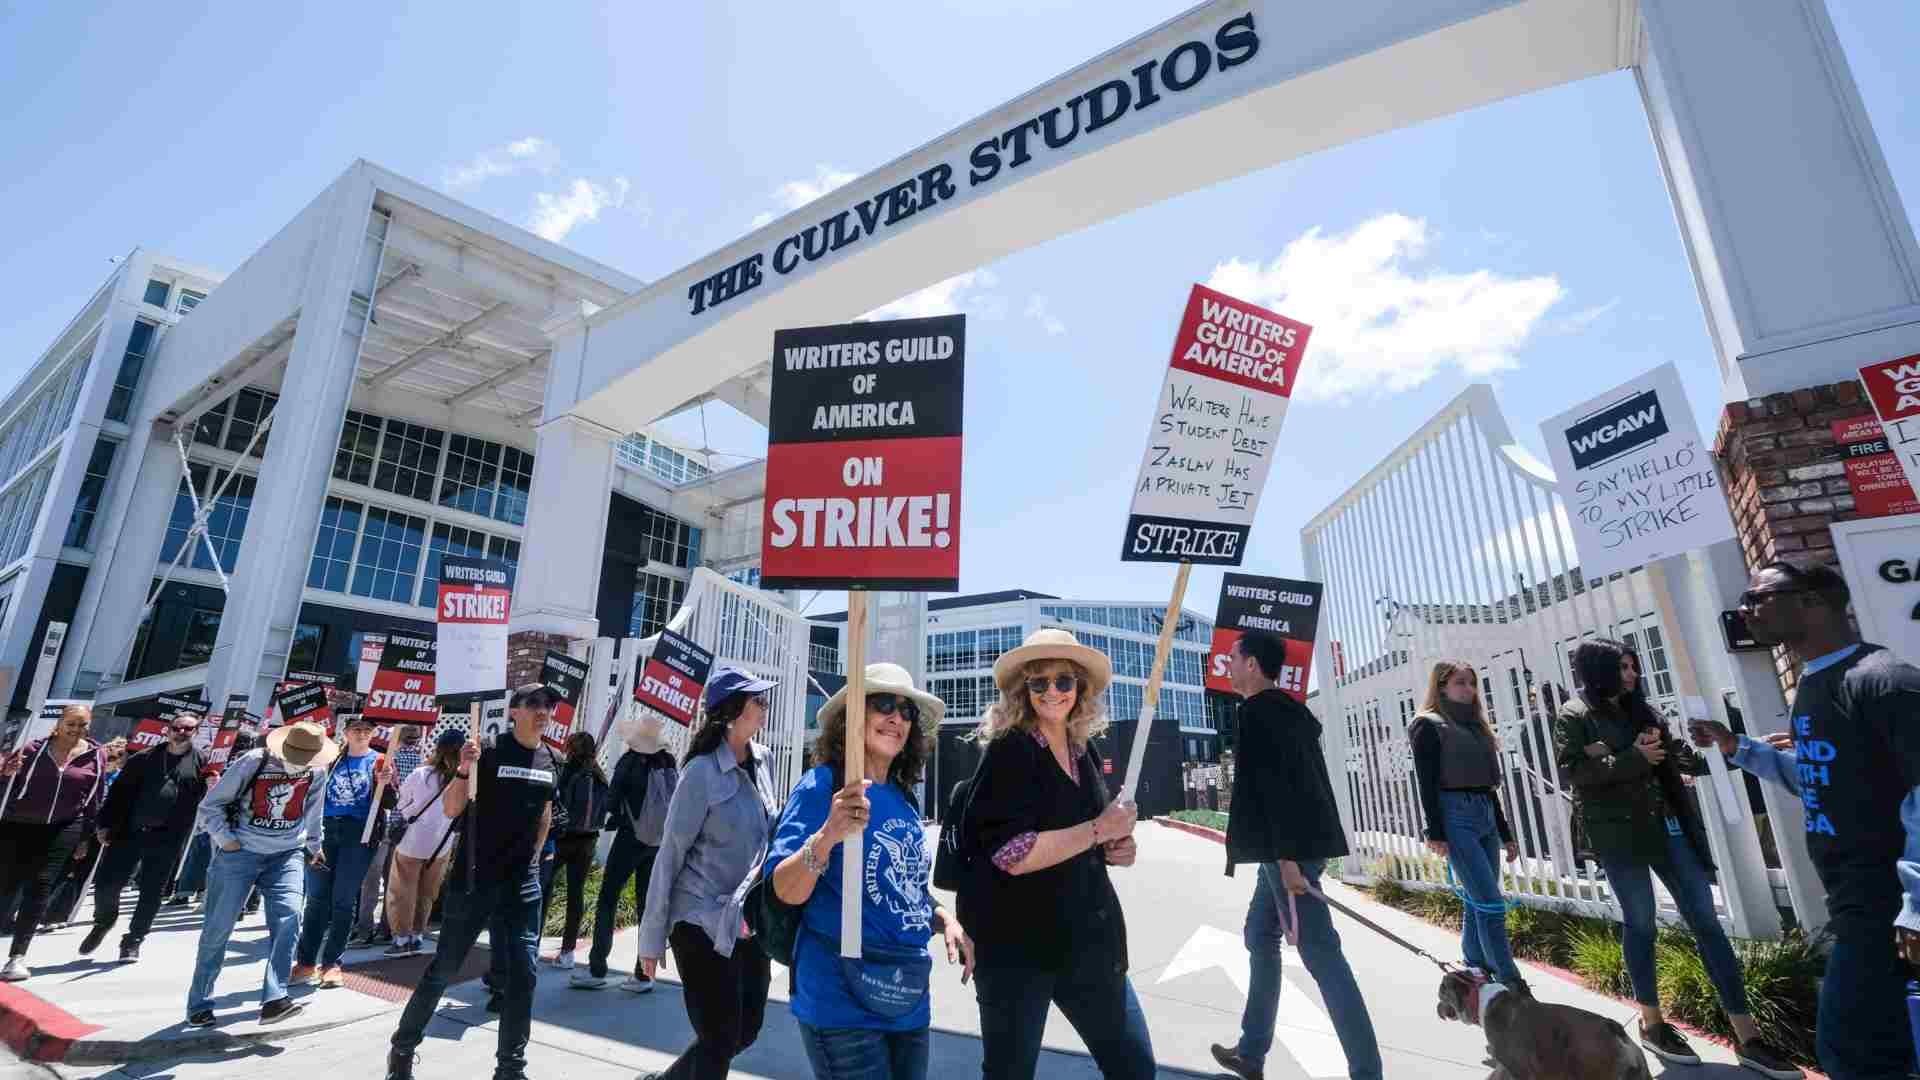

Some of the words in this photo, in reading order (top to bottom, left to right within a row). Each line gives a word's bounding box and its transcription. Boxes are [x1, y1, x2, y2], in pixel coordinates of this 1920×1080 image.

[688, 252, 763, 315] THE
[772, 163, 956, 274] CULVER
[969, 12, 1260, 187] STUDIOS
[1200, 298, 1297, 348] WRITERS
[784, 340, 881, 371] WRITERS
[885, 335, 954, 363] GUILD
[1196, 322, 1266, 360] GUILD
[1265, 347, 1287, 365] OF
[1184, 342, 1285, 387] AMERICA
[852, 374, 877, 394] OF
[812, 401, 915, 430] AMERICA
[1571, 404, 1657, 454] WGAW
[1849, 441, 1885, 456] FIRE
[843, 456, 883, 487] ON
[1140, 477, 1151, 493] A
[1575, 473, 1619, 504] SAY
[1577, 505, 1602, 525] TO
[1616, 483, 1653, 512] MY
[1660, 470, 1716, 502] LITTLE
[770, 493, 951, 549] STRIKE!
[1600, 494, 1700, 548] STRIKE
[1133, 523, 1240, 558] STRIKE
[445, 565, 484, 581] WRITERS
[485, 570, 506, 583] GUILD
[444, 591, 505, 620] STRIKE!
[1227, 585, 1277, 601] WRITERS
[1278, 591, 1313, 606] GUILD
[1260, 604, 1272, 614] OF
[1238, 615, 1290, 632] AMERICA
[391, 635, 430, 649] WRITERS
[416, 651, 426, 659] OF
[404, 679, 422, 690] ON
[641, 675, 696, 714] STRIKE!
[669, 675, 682, 688] ON
[866, 842, 883, 906] WRITERS
